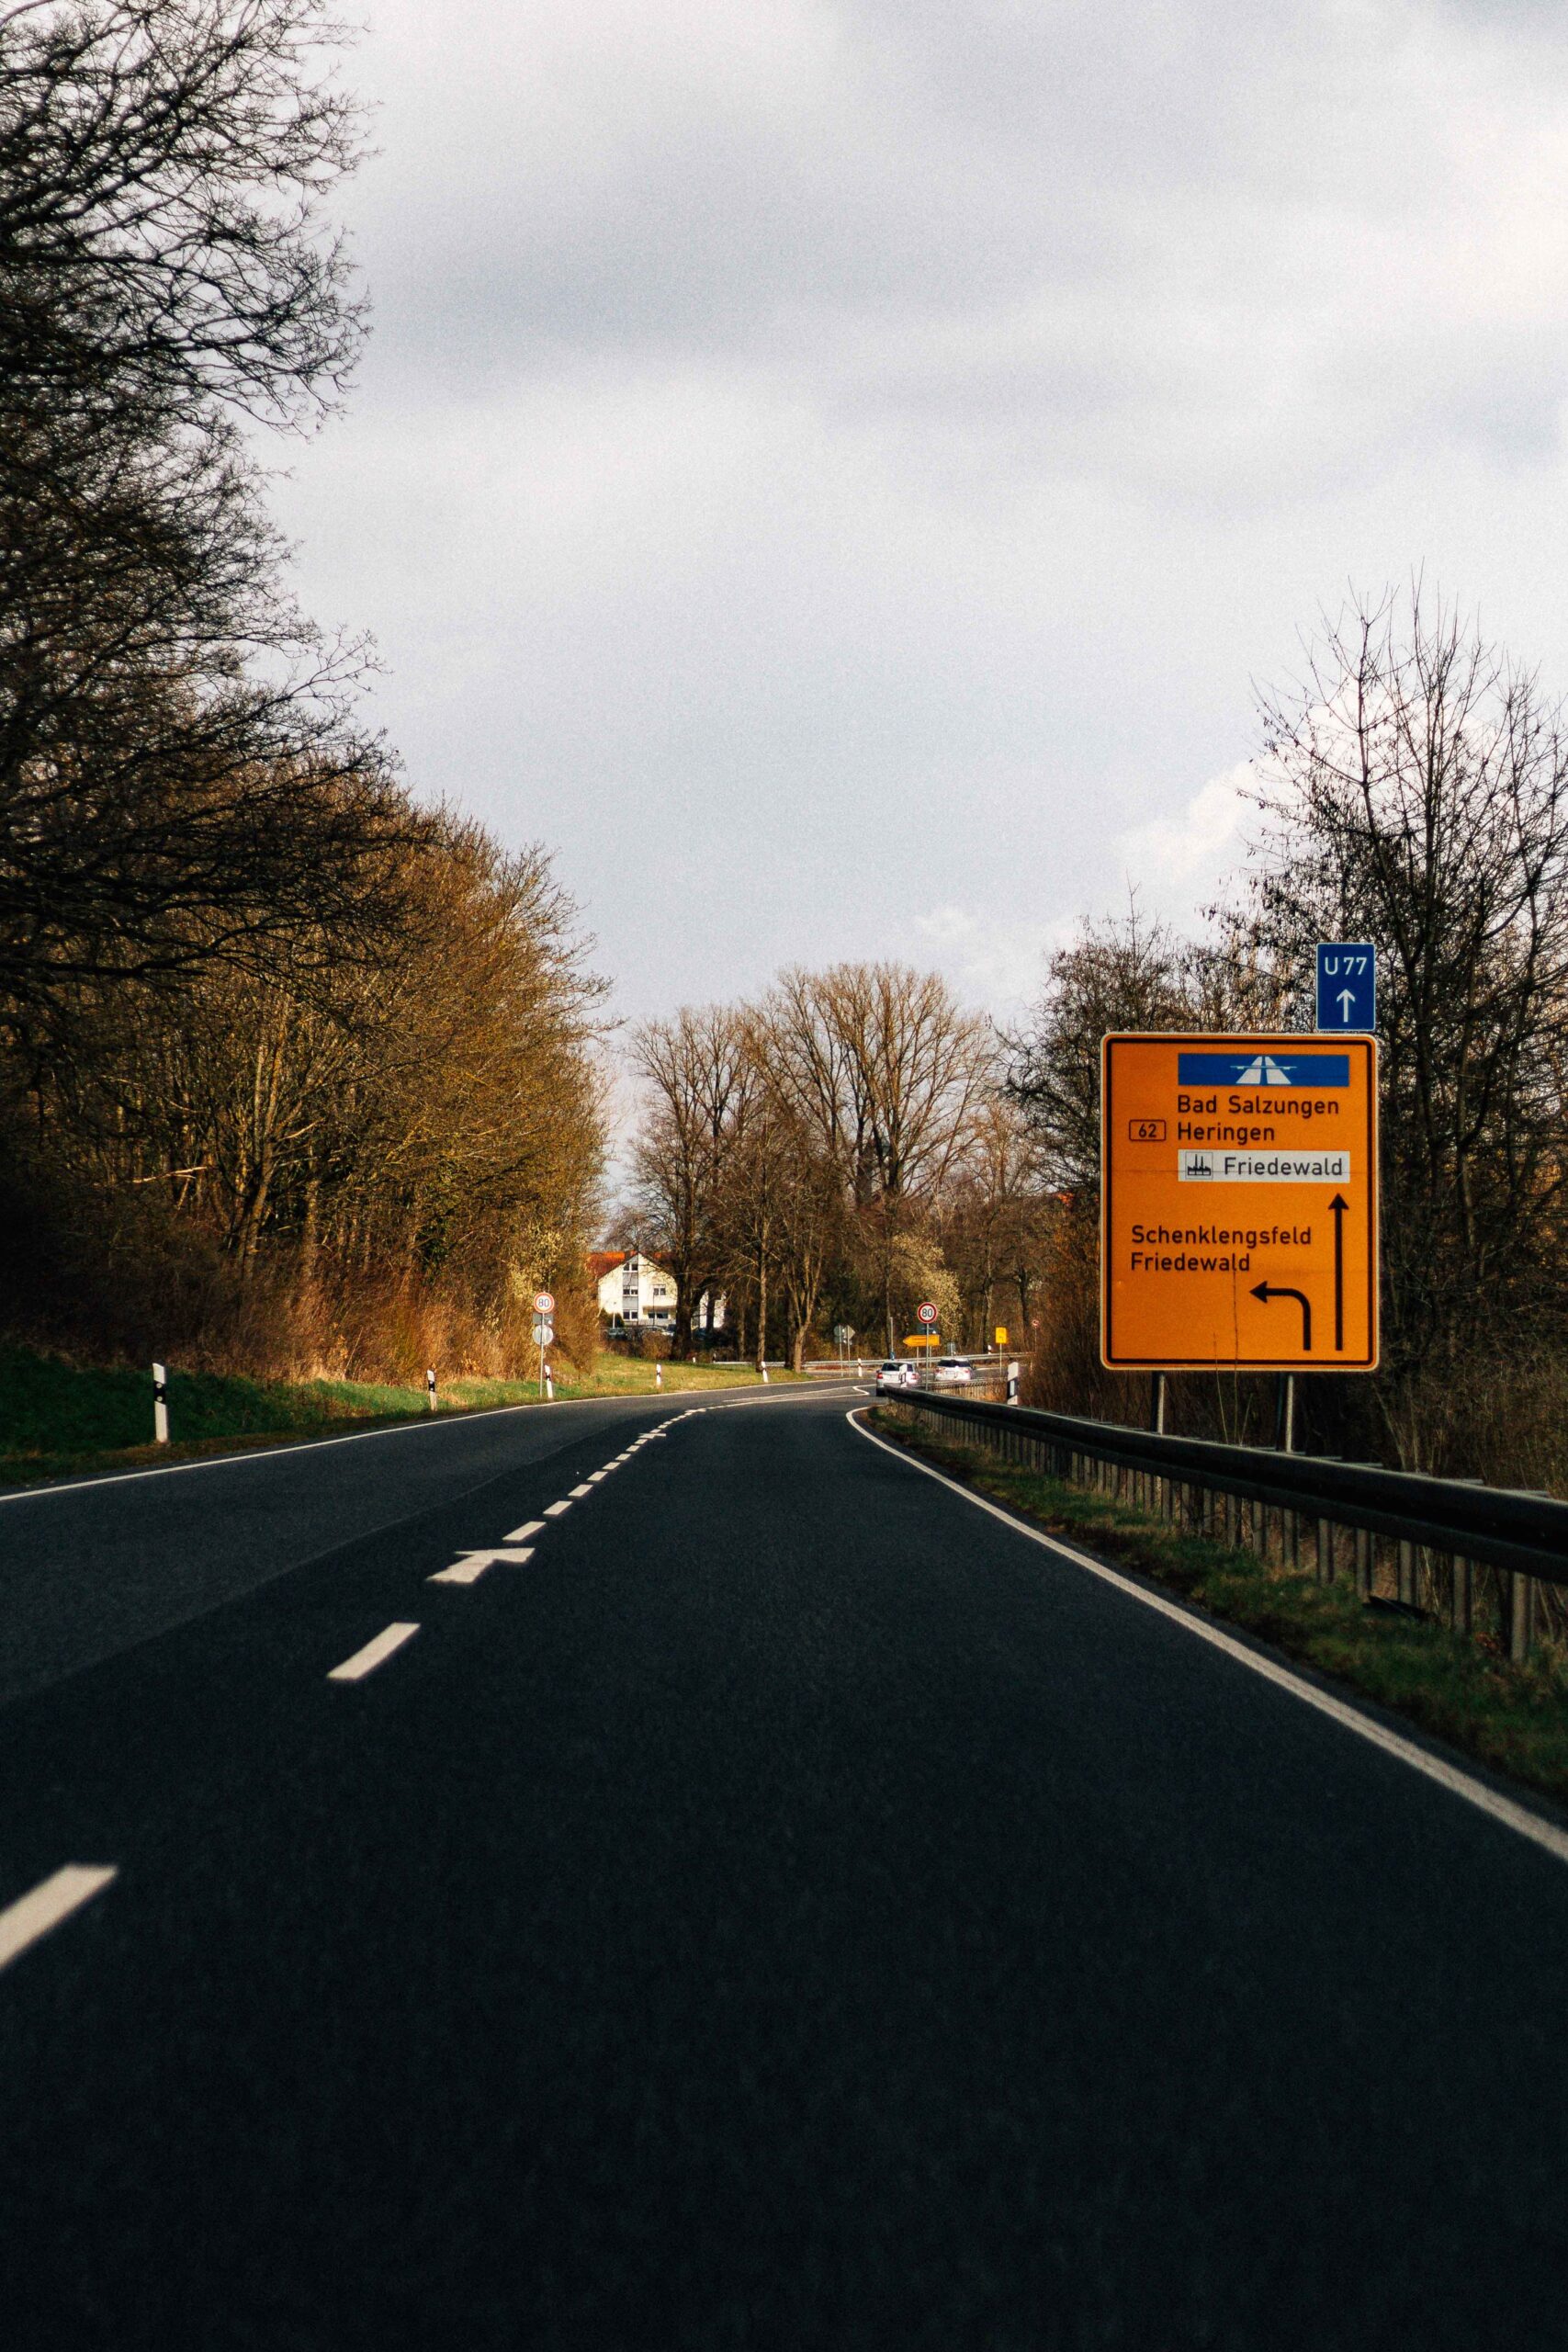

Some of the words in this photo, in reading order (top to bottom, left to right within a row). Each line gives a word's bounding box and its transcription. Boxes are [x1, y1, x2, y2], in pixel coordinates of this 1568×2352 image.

[1177, 1094, 1217, 1114] Bad
[1228, 1095, 1339, 1119] Salzungen
[1138, 1123, 1157, 1138] 62
[1177, 1122, 1275, 1146] Heringen
[1224, 1157, 1343, 1176] Friedewald
[1131, 1225, 1312, 1250] Schenklengsfeld
[1131, 1252, 1250, 1272] Friedewald
[538, 1298, 549, 1307] 80
[921, 1308, 933, 1317] 80
